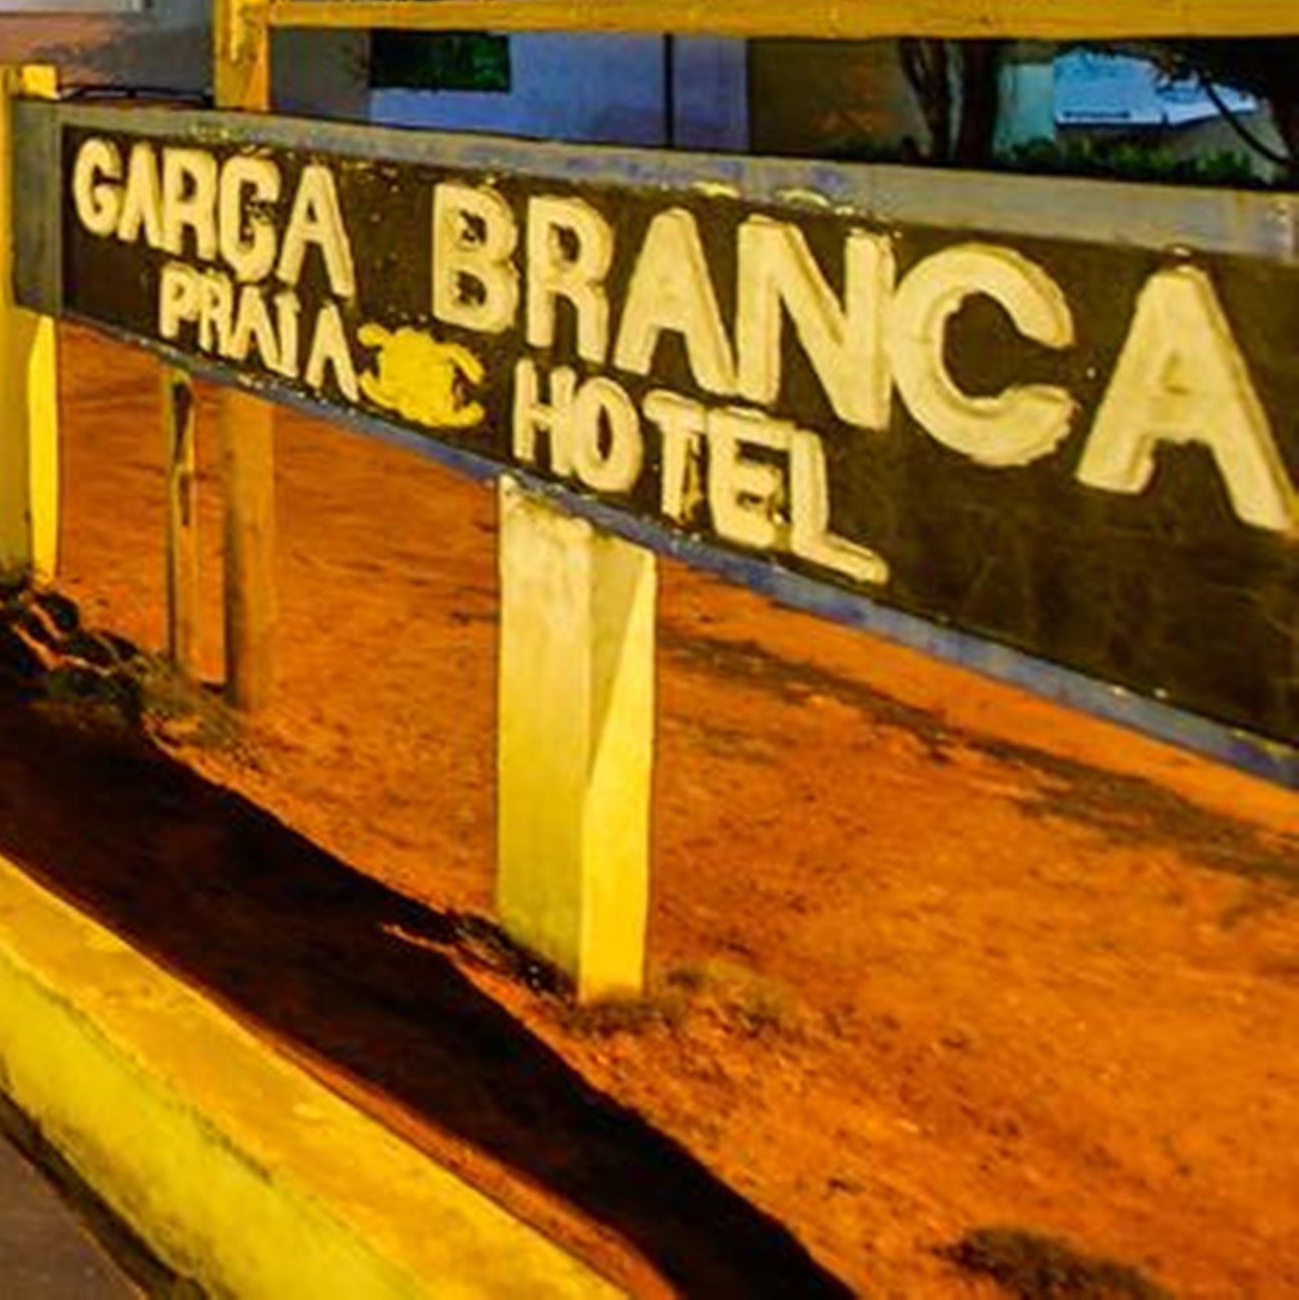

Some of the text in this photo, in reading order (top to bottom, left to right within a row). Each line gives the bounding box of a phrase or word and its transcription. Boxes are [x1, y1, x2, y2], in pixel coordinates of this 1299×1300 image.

[159, 262, 890, 585] PRAIA HOTEL
[431, 182, 1299, 534] BRANCA
